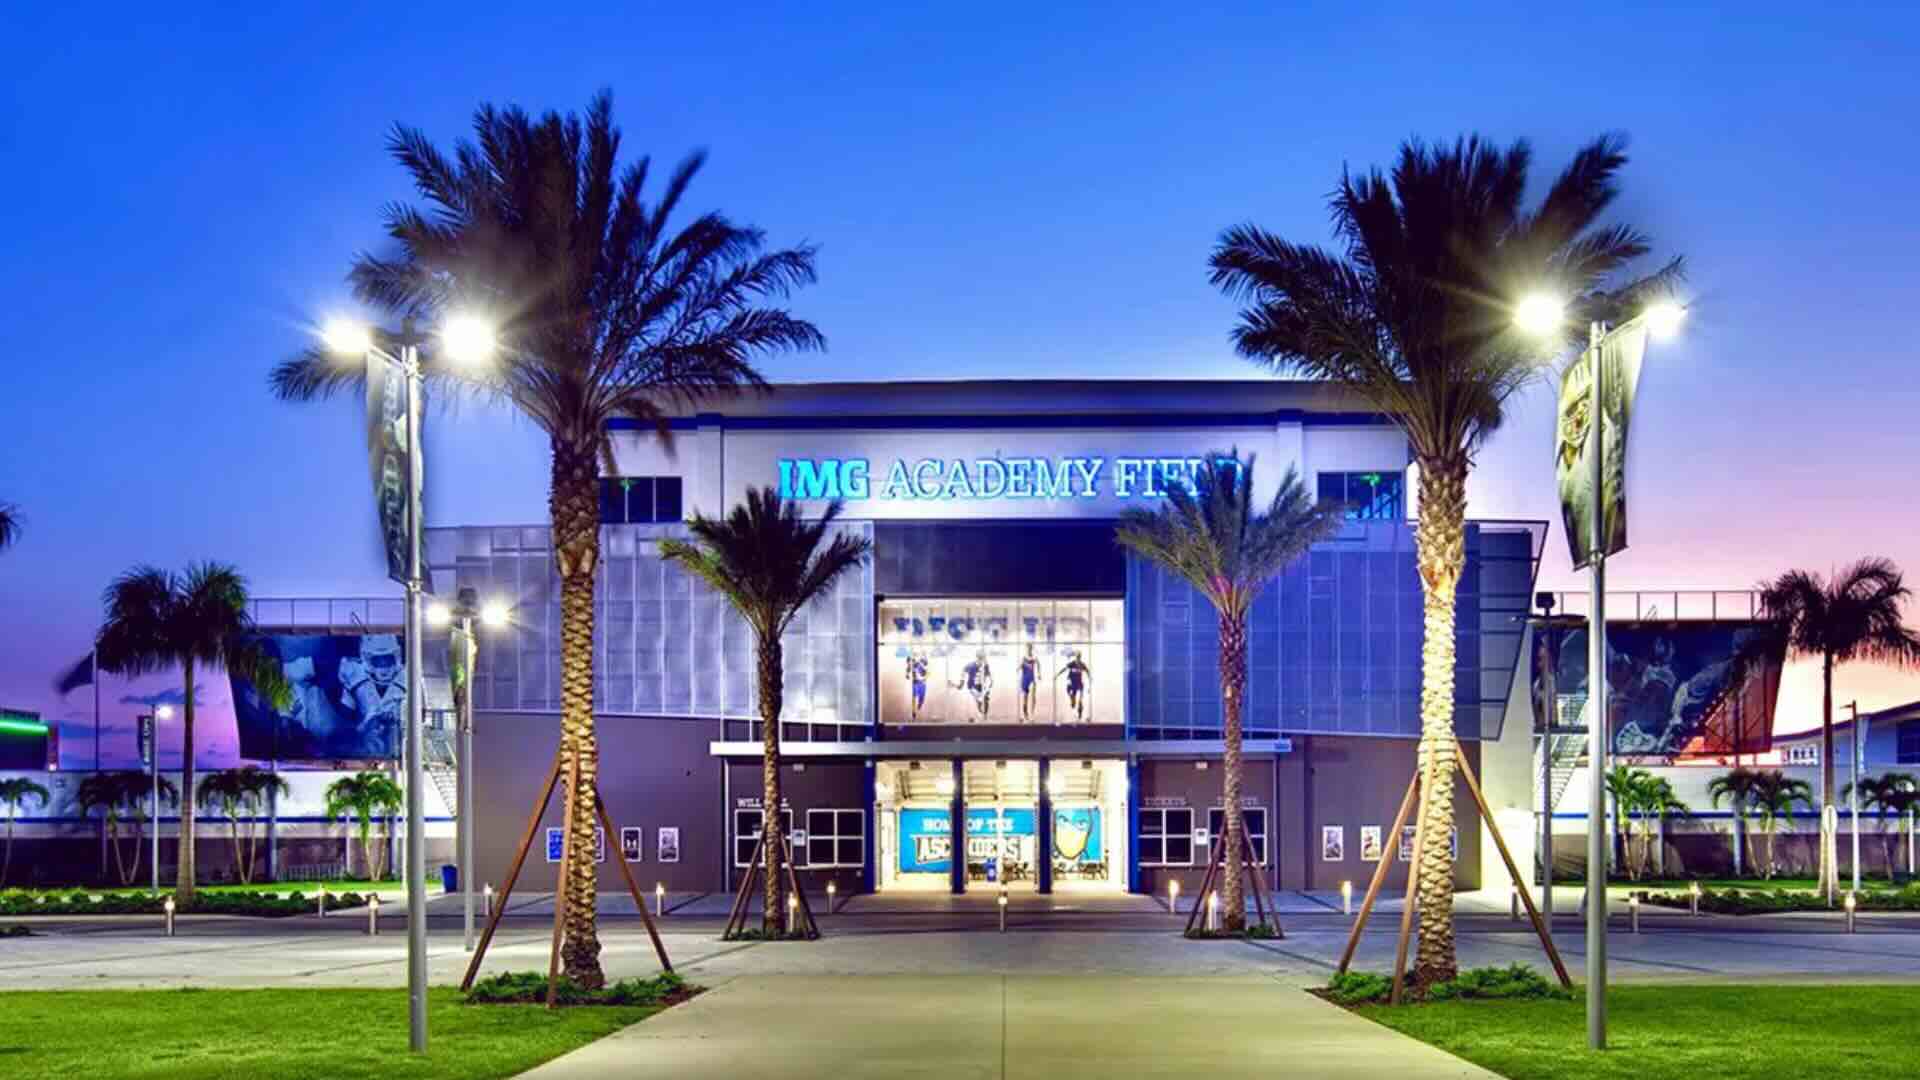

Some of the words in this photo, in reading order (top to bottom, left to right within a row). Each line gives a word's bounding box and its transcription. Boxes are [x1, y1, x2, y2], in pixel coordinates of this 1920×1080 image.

[778, 459, 868, 499] IMG
[882, 459, 1103, 499] ACADEMY
[967, 818, 984, 831] OF
